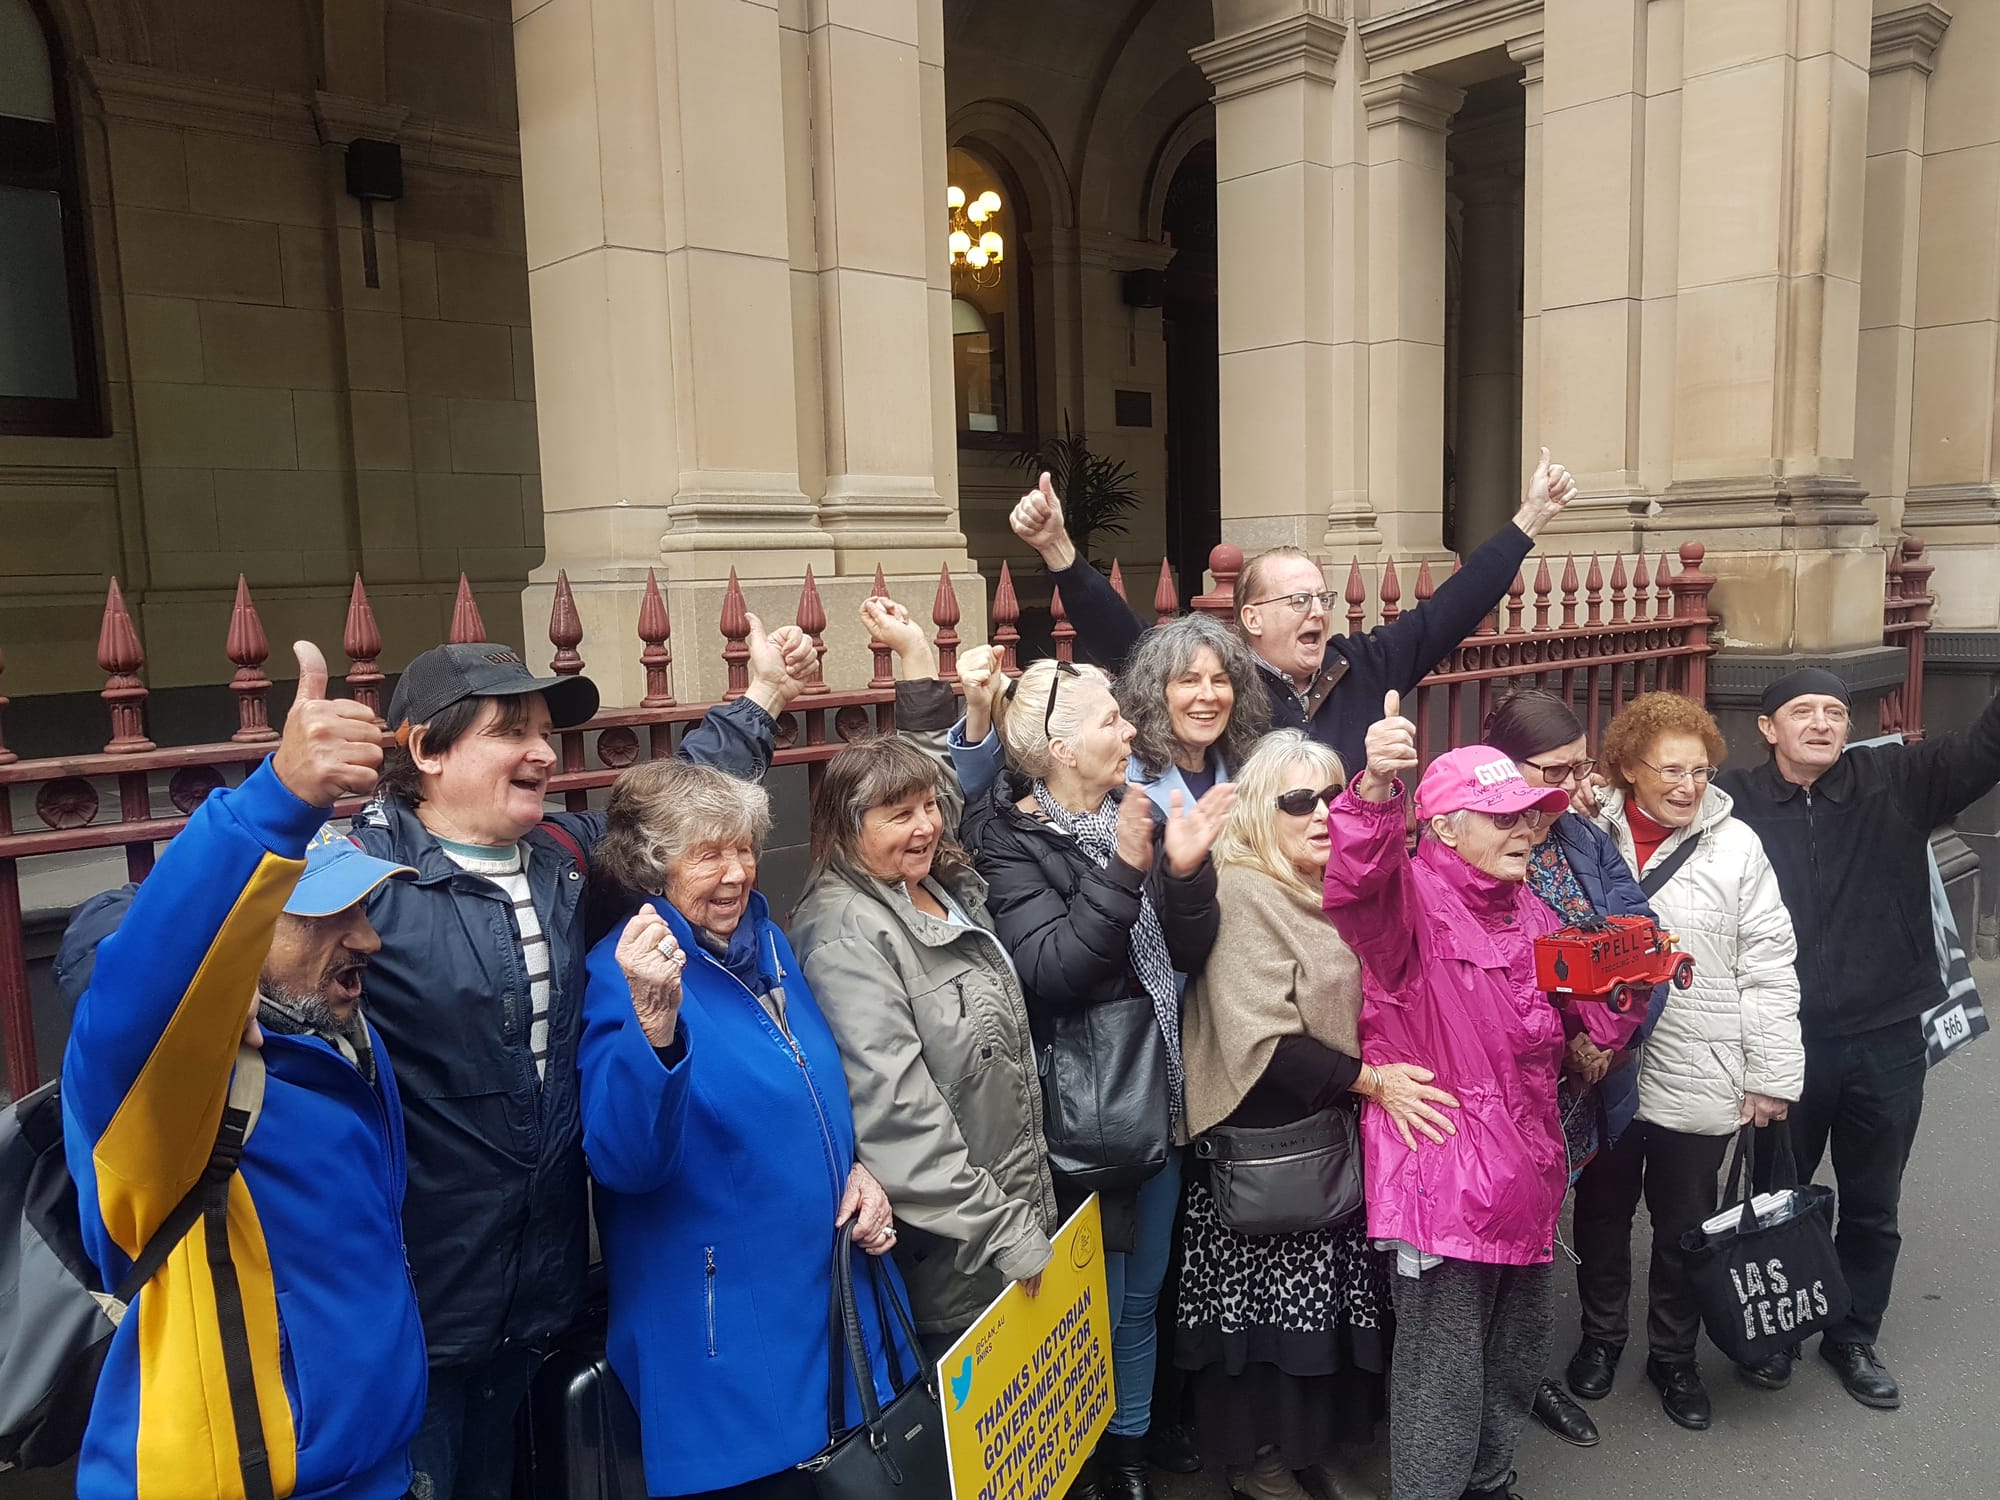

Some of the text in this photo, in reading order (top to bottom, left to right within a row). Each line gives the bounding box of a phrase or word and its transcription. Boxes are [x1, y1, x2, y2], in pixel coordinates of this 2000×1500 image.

[1603, 933, 1640, 960] PELL
[1943, 1014, 1963, 1040] 666
[1730, 1258, 1788, 1304] LAS
[975, 1286, 1092, 1444] THANKS VICTORIAN
[984, 1318, 1090, 1470] GOVERNMENT FOR
[1038, 1336, 1099, 1434] CHILDREN'S
[1028, 1422, 1060, 1484] FIRST
[1063, 1410, 1071, 1433] &
[1075, 1355, 1106, 1418] ABOVE
[1028, 1382, 1108, 1500] HOLIC CHURCH
